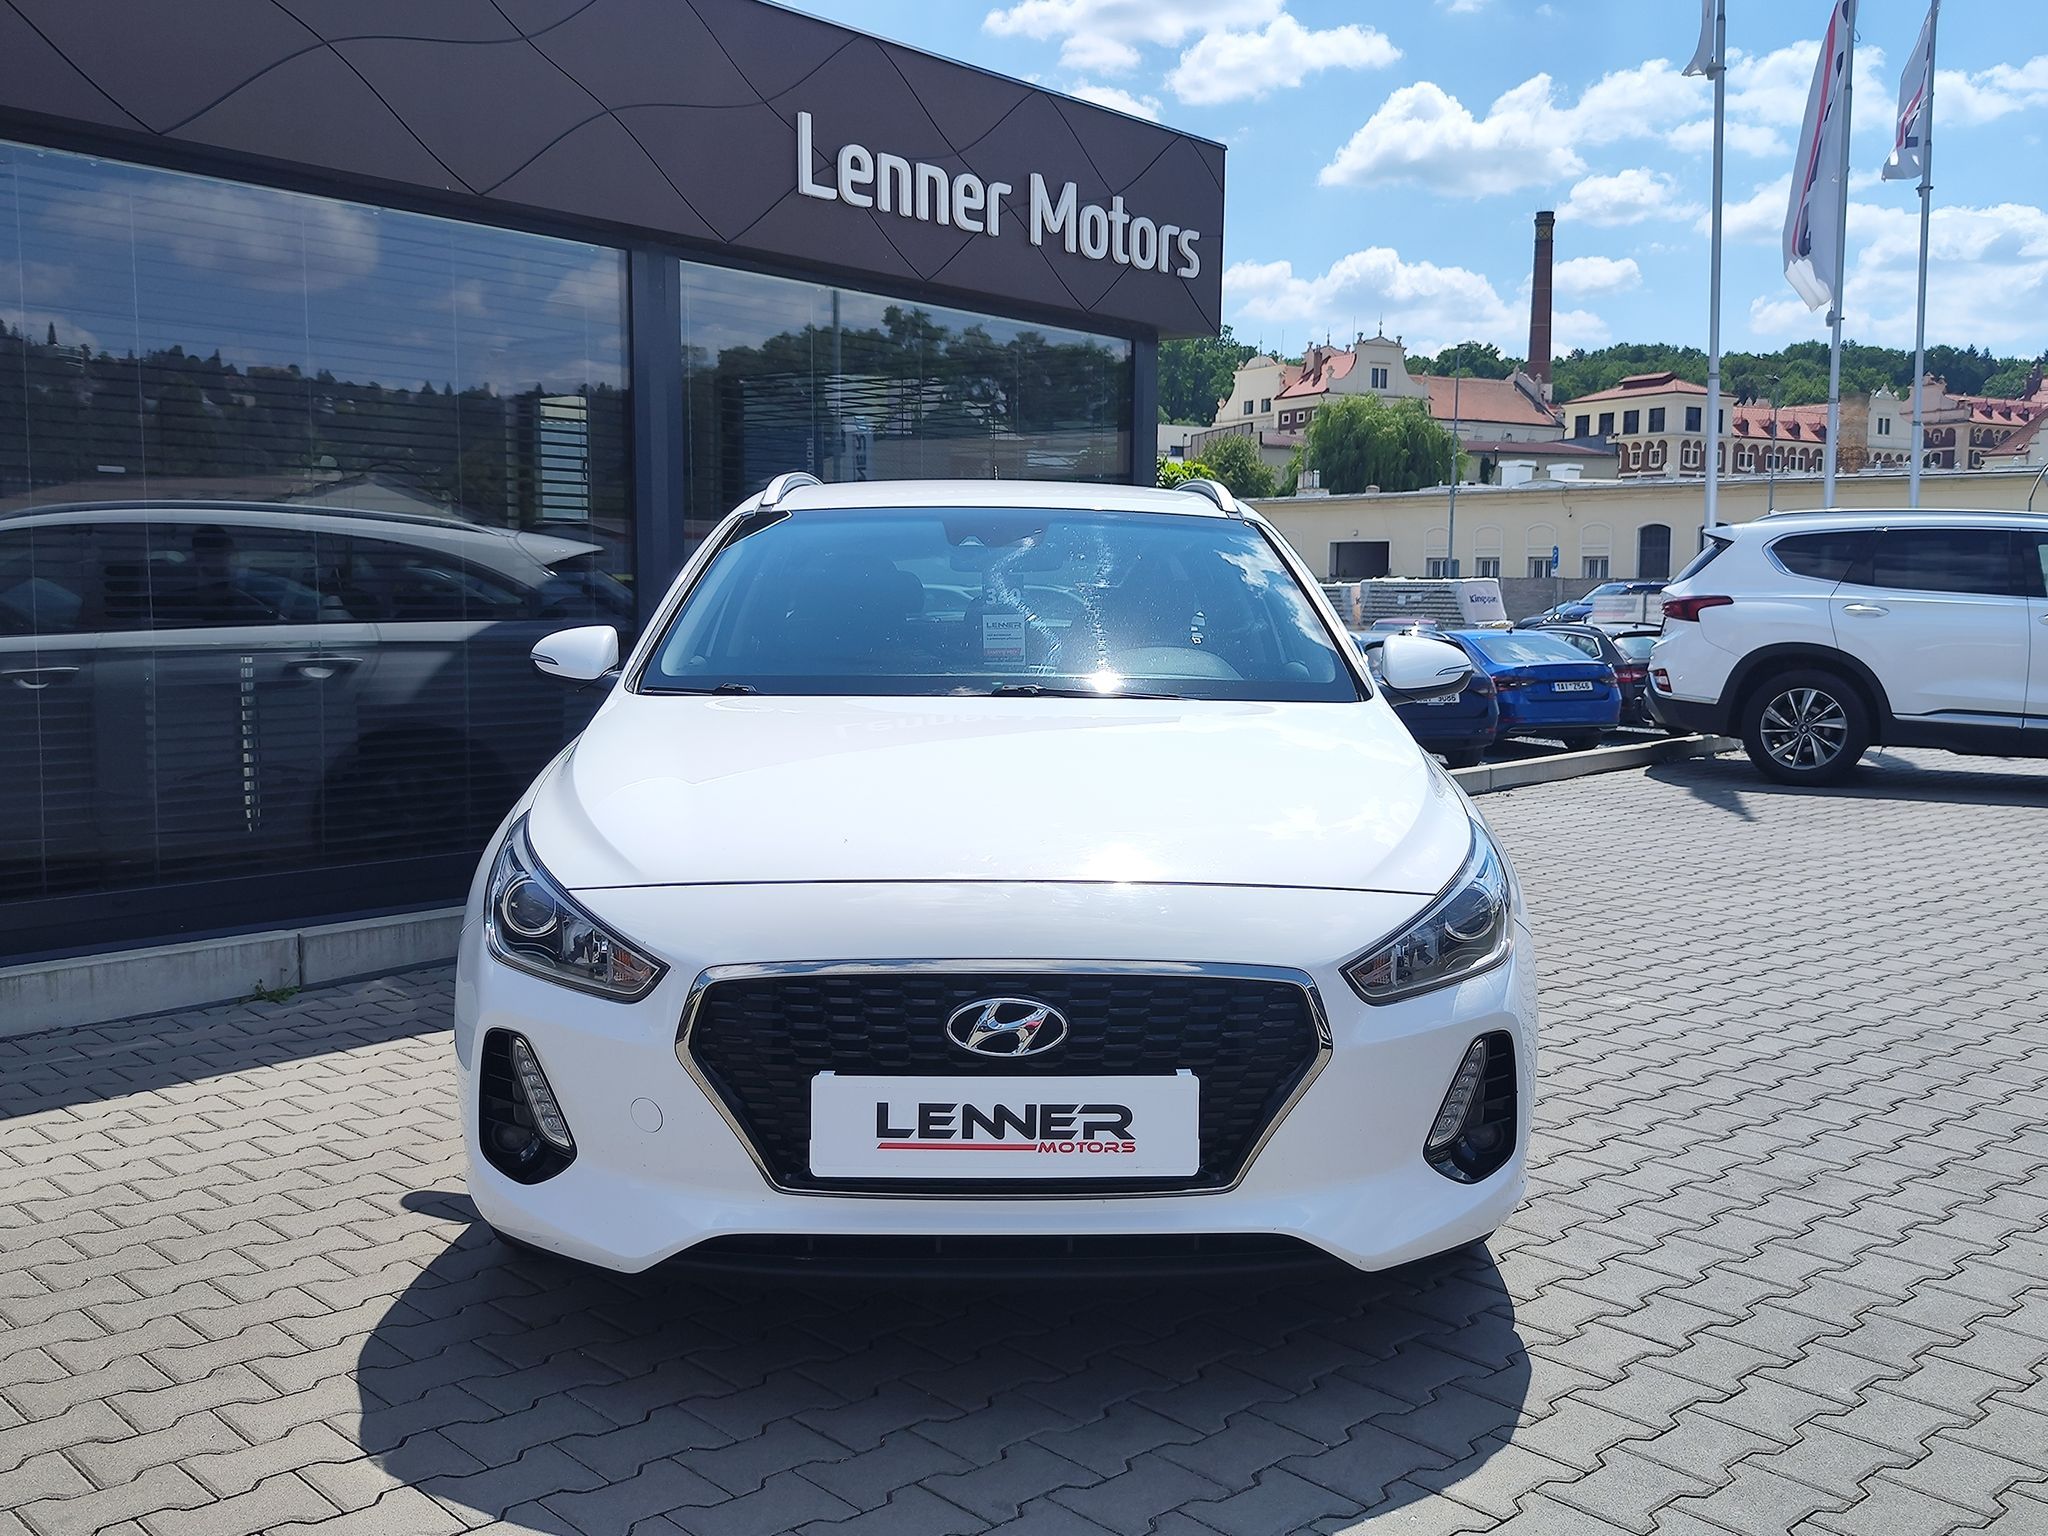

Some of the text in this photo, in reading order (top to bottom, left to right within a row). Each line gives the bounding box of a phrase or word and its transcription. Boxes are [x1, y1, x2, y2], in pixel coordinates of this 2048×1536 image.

[796, 111, 1201, 279] Lenner Motors
[876, 1102, 1137, 1140] LENNER
[1037, 1142, 1136, 1154] MOTORS
